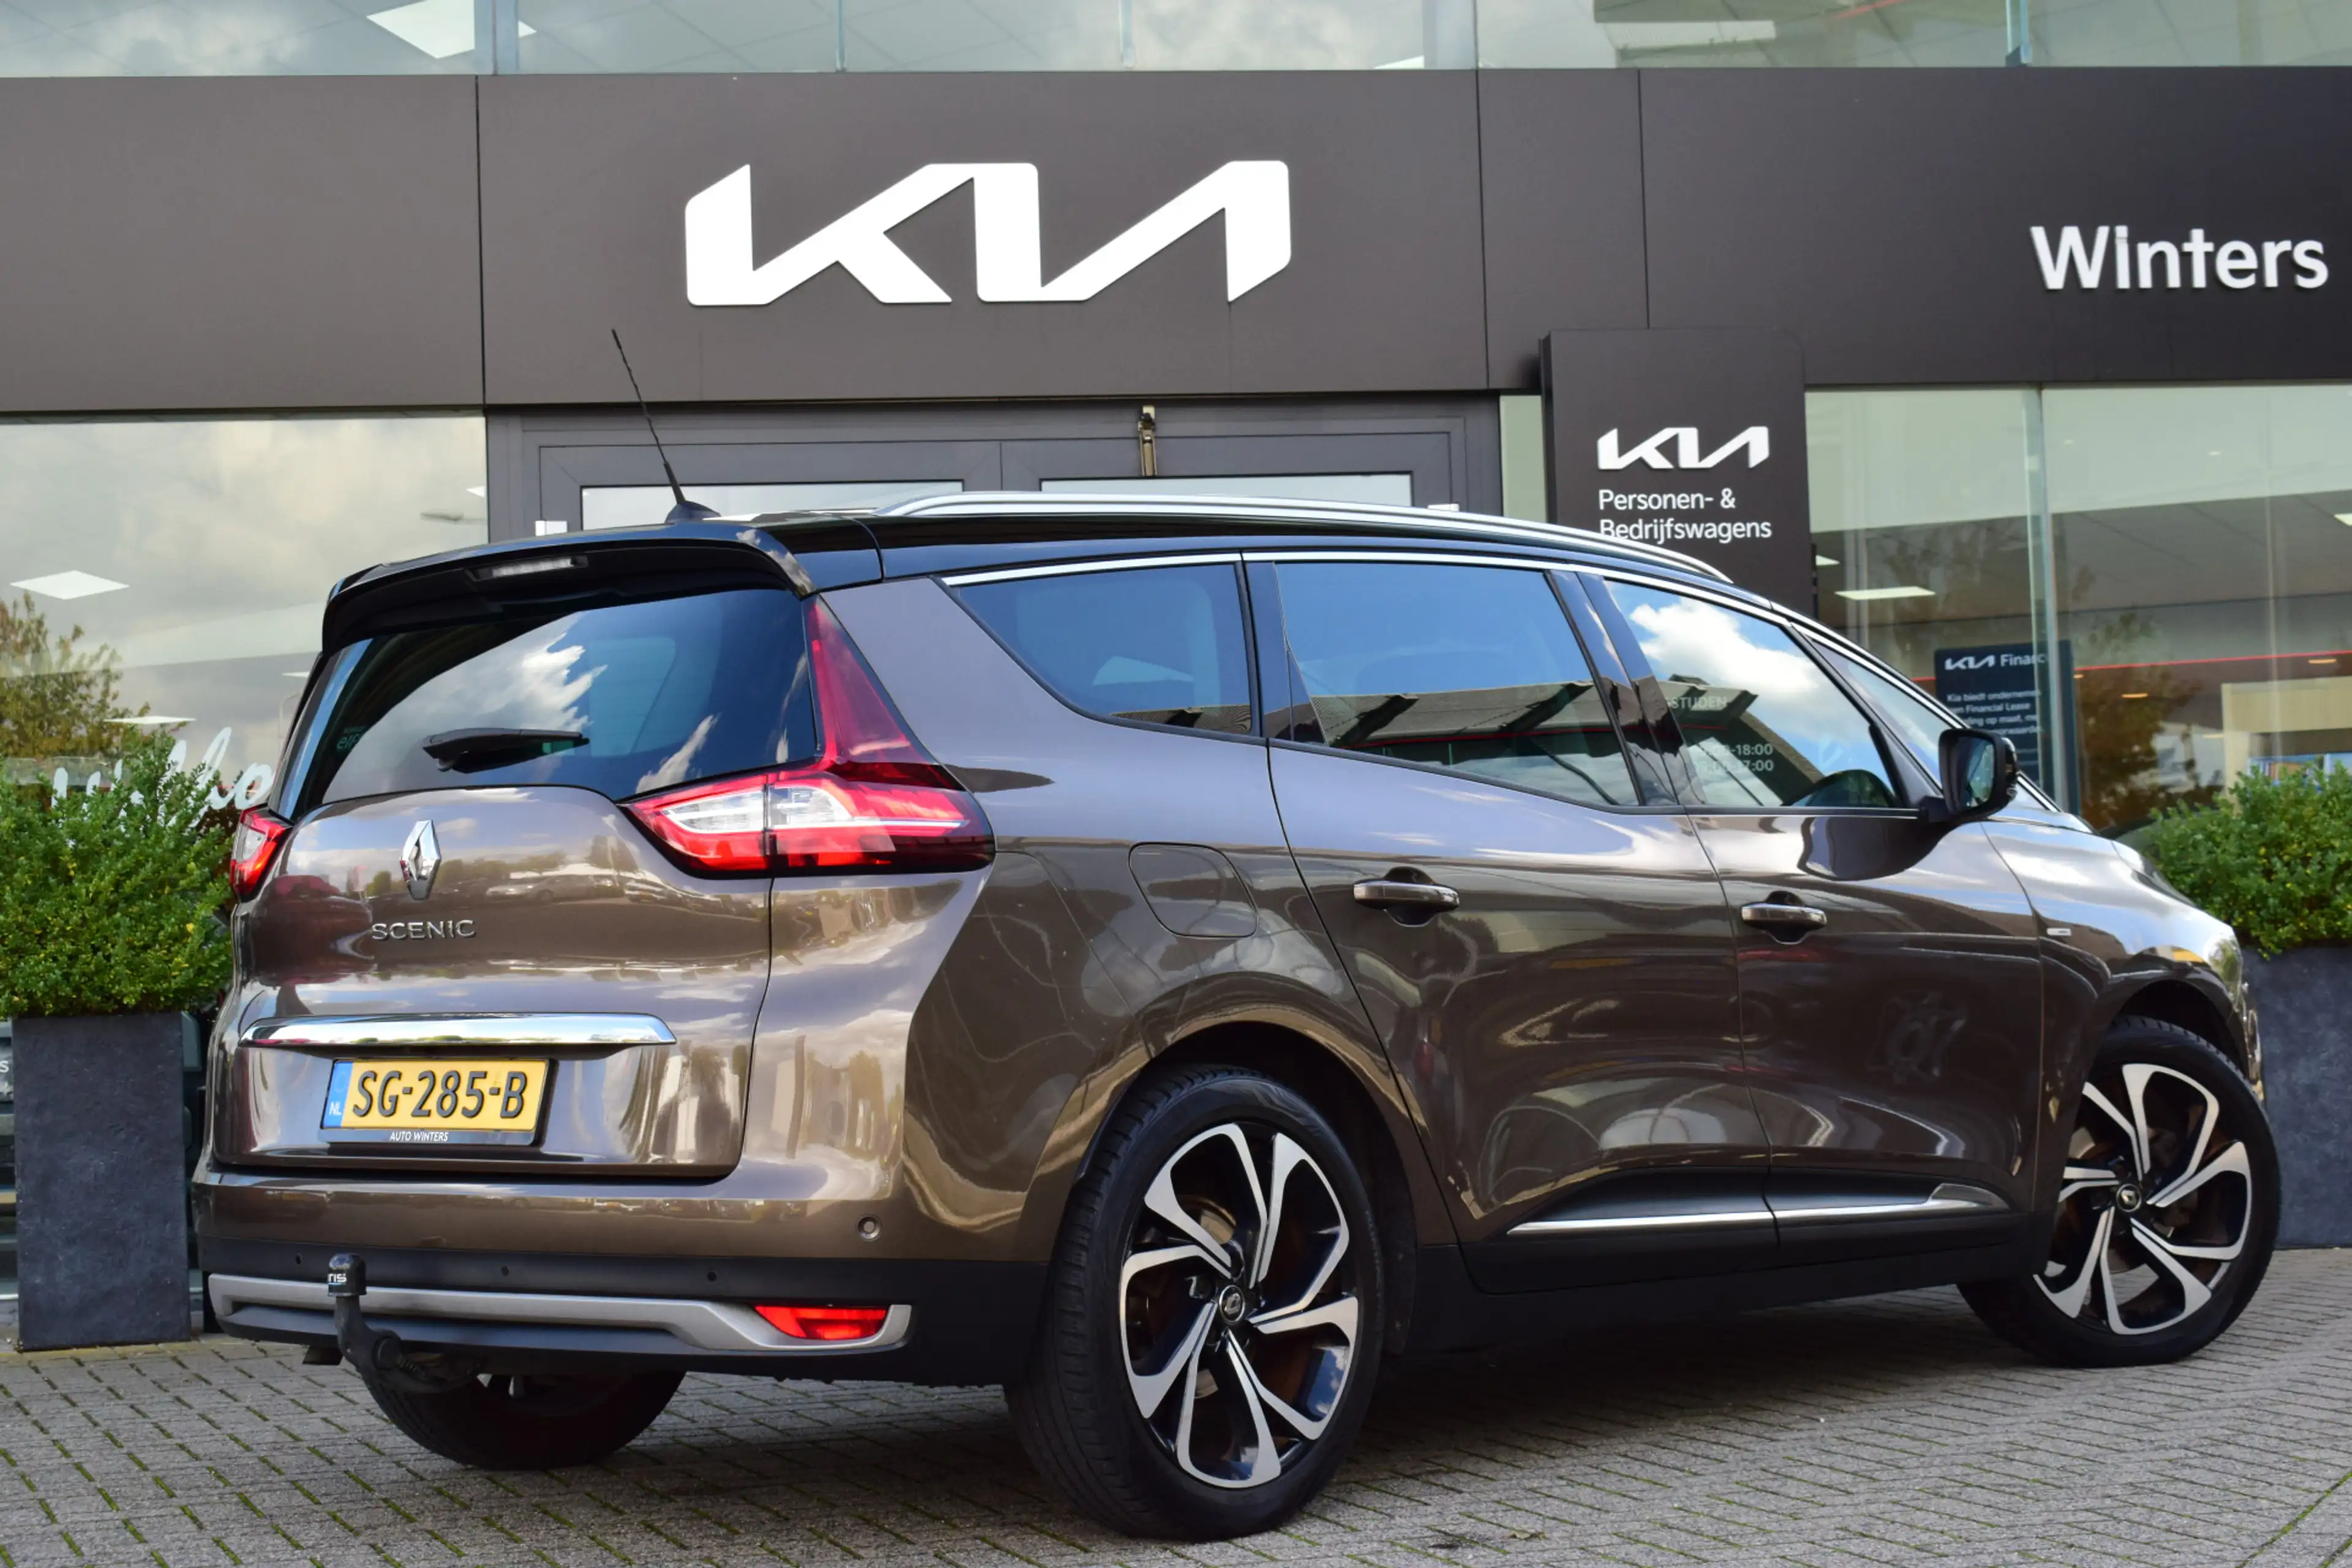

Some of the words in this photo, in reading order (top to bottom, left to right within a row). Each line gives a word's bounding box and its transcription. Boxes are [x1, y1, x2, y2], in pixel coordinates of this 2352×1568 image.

[685, 160, 1292, 306] KIA
[2030, 225, 2329, 290] Winters
[1597, 426, 1770, 470] KIA
[1599, 489, 1714, 510] Personen-
[1720, 488, 1736, 509] &
[1599, 518, 1772, 545] Bedrijfswagens
[2000, 654, 2048, 666] Financ
[1966, 704, 2003, 713] Financial
[371, 920, 476, 940] SCENIC
[352, 1069, 527, 1118] SG-285-B
[329, 1101, 342, 1115] NL
[390, 1131, 412, 1141] AUTO
[413, 1131, 449, 1142] WINTERS
